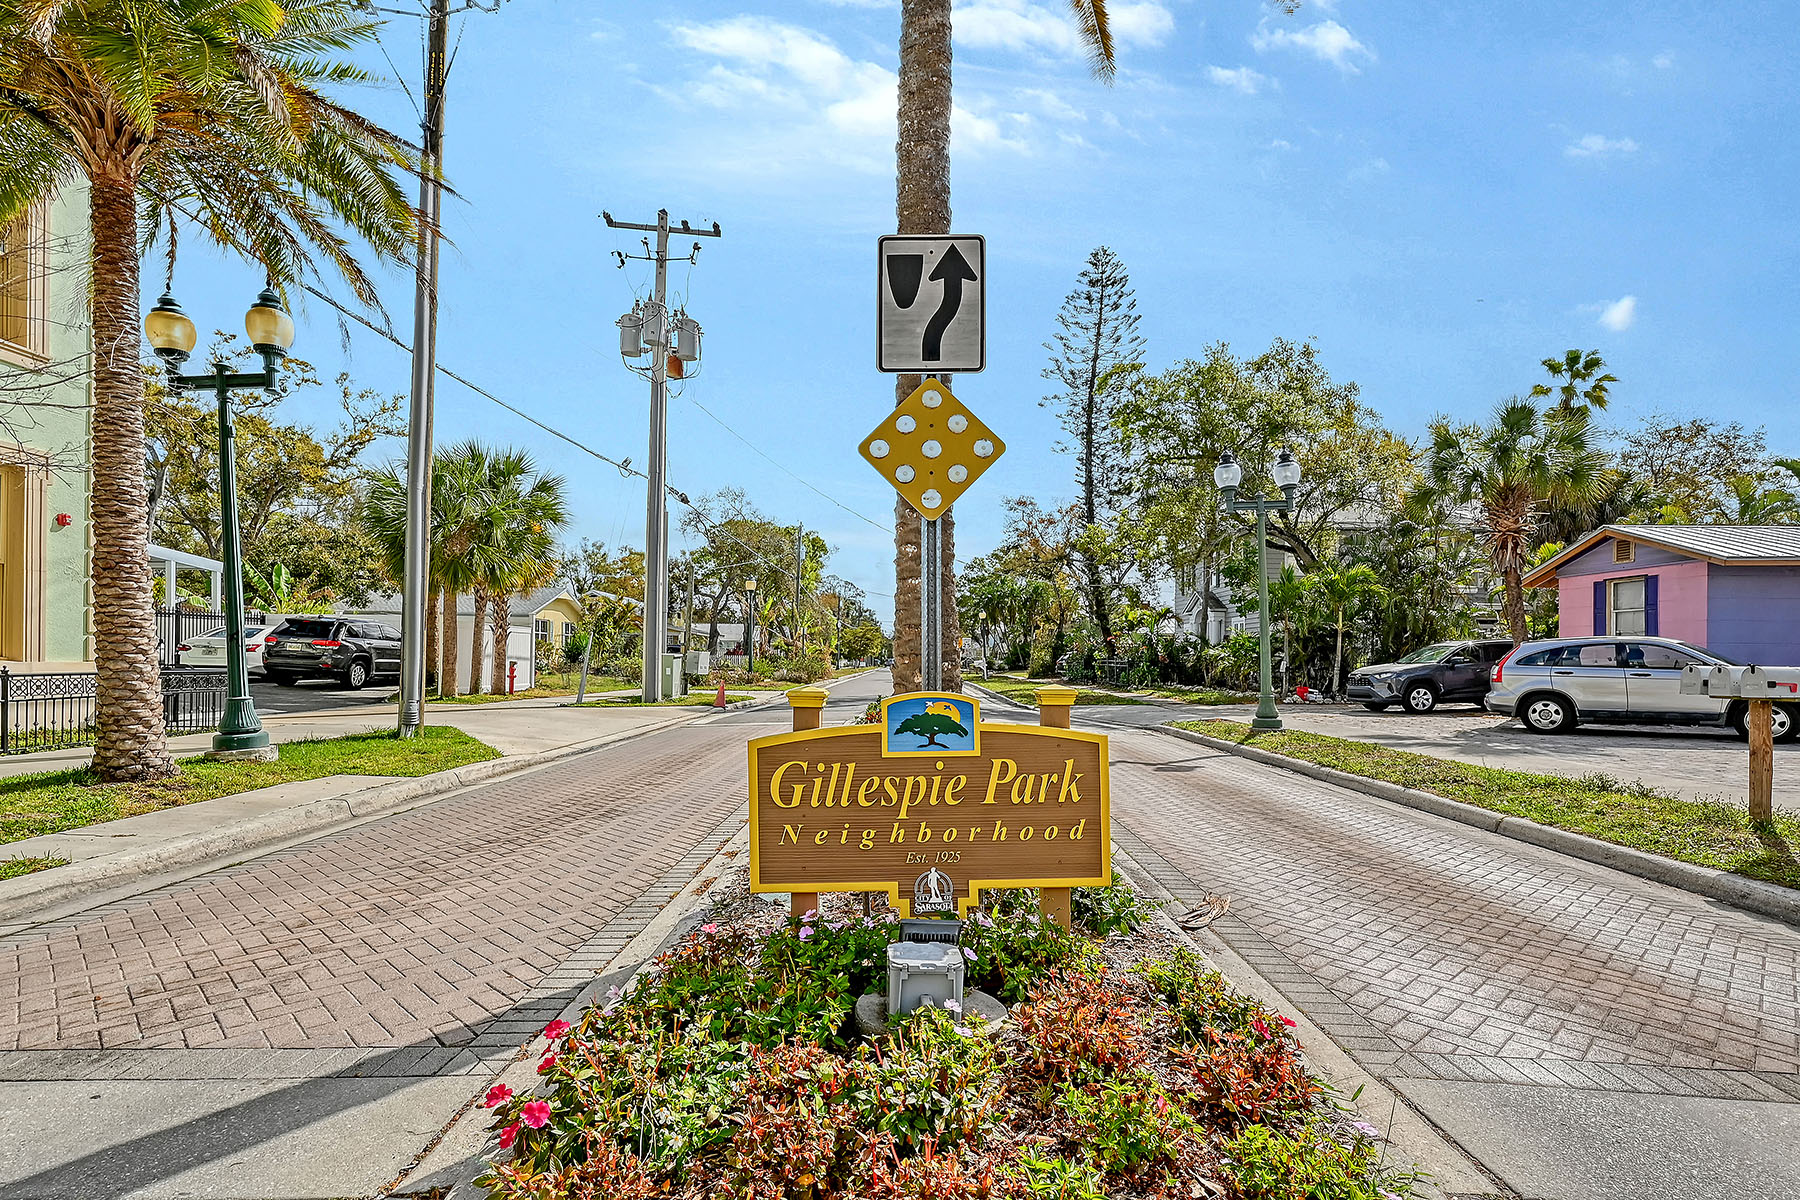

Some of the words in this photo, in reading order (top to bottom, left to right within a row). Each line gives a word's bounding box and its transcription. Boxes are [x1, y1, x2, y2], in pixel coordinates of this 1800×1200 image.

[770, 761, 967, 819] Gillespie
[981, 758, 1084, 805] Park
[779, 819, 1087, 850] Neighborhood
[905, 851, 929, 864] Est.
[934, 850, 962, 864] 1925
